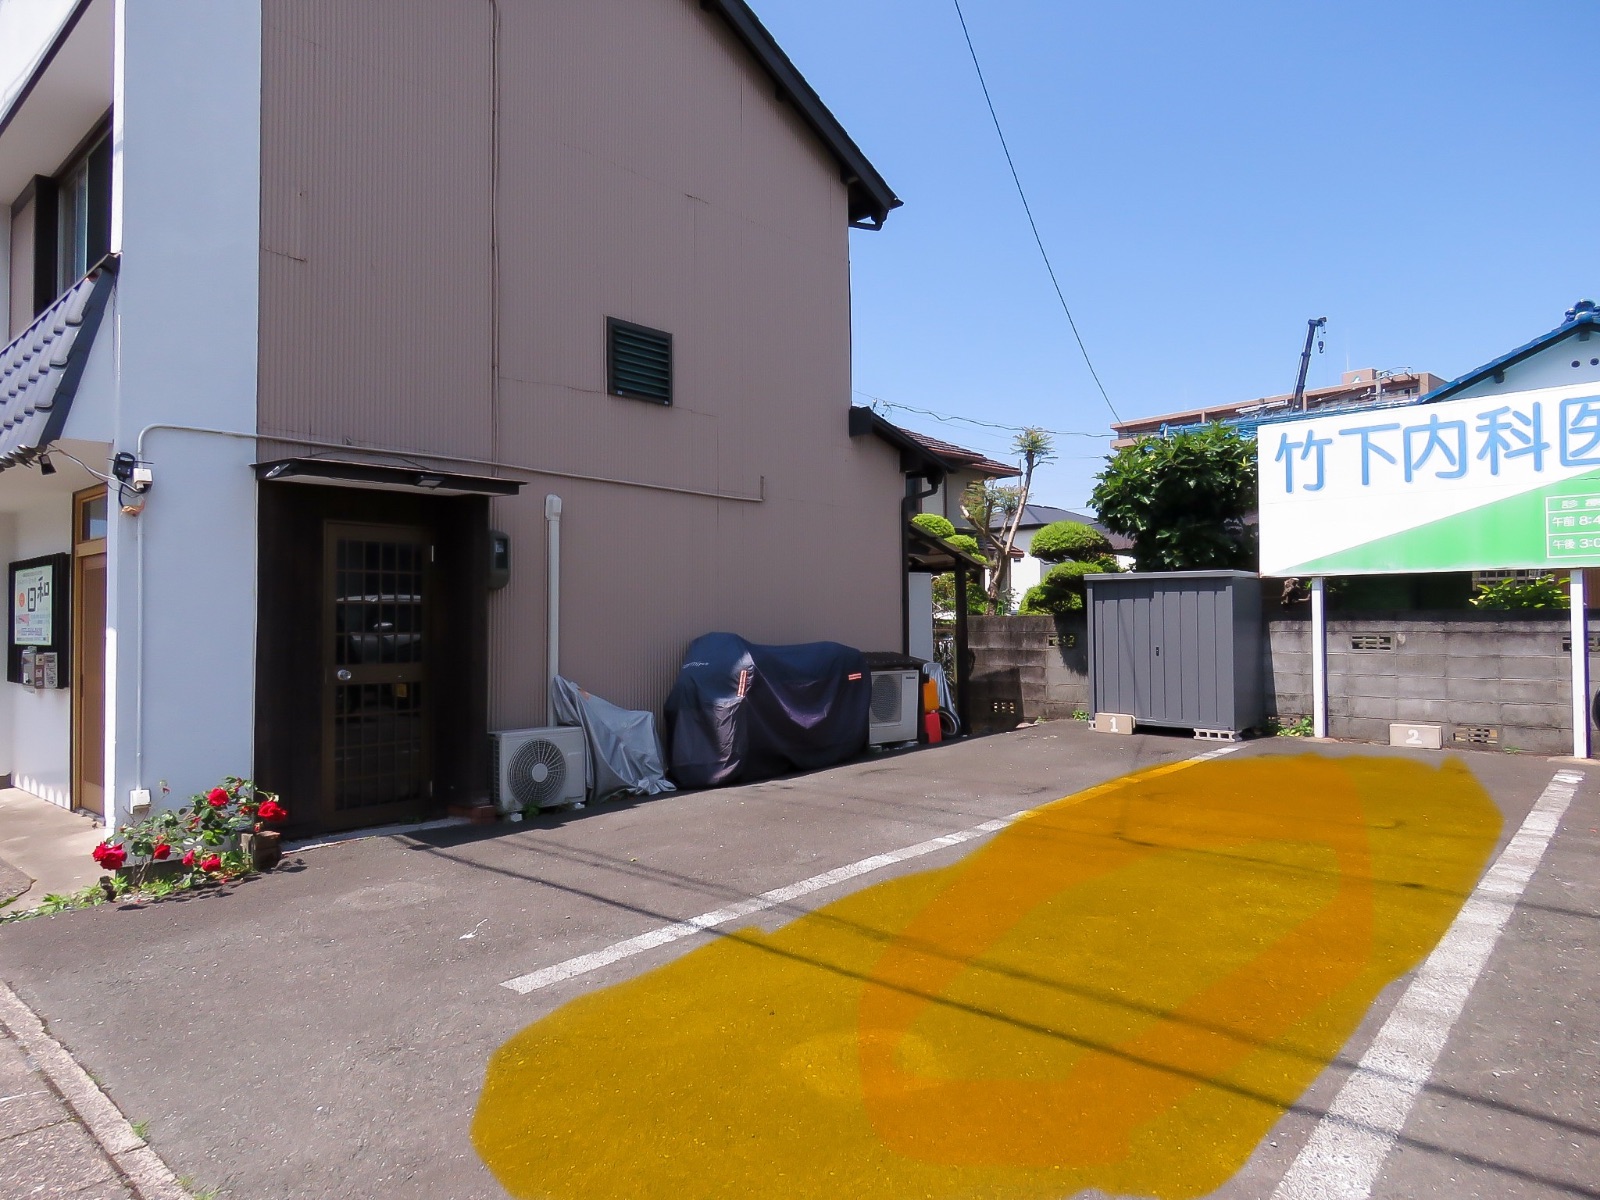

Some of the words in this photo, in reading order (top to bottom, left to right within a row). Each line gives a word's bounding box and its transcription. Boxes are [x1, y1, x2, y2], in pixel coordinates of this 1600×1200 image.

[1274, 395, 1600, 494] 竹下内科医
[1110, 716, 1119, 733] 1
[1405, 729, 1423, 745] 2
